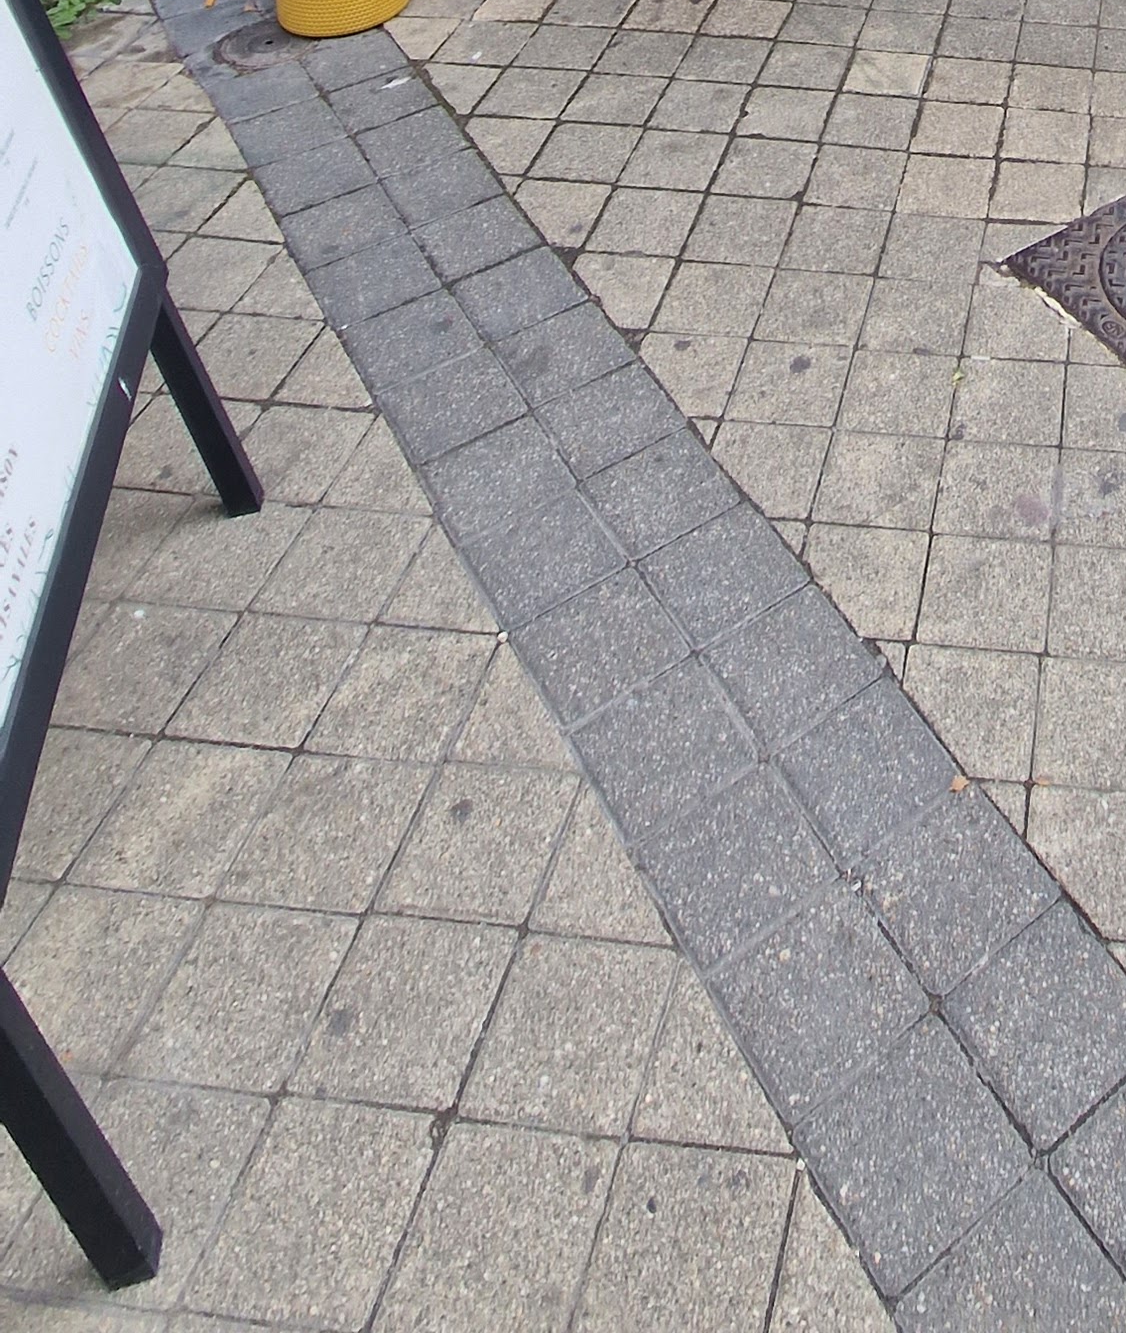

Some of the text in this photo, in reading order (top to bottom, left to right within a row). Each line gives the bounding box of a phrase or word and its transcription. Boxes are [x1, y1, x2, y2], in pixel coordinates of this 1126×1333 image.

[26, 216, 70, 322] BOISSONS
[44, 244, 89, 354] COCKTAILS
[69, 308, 91, 359] VINS
